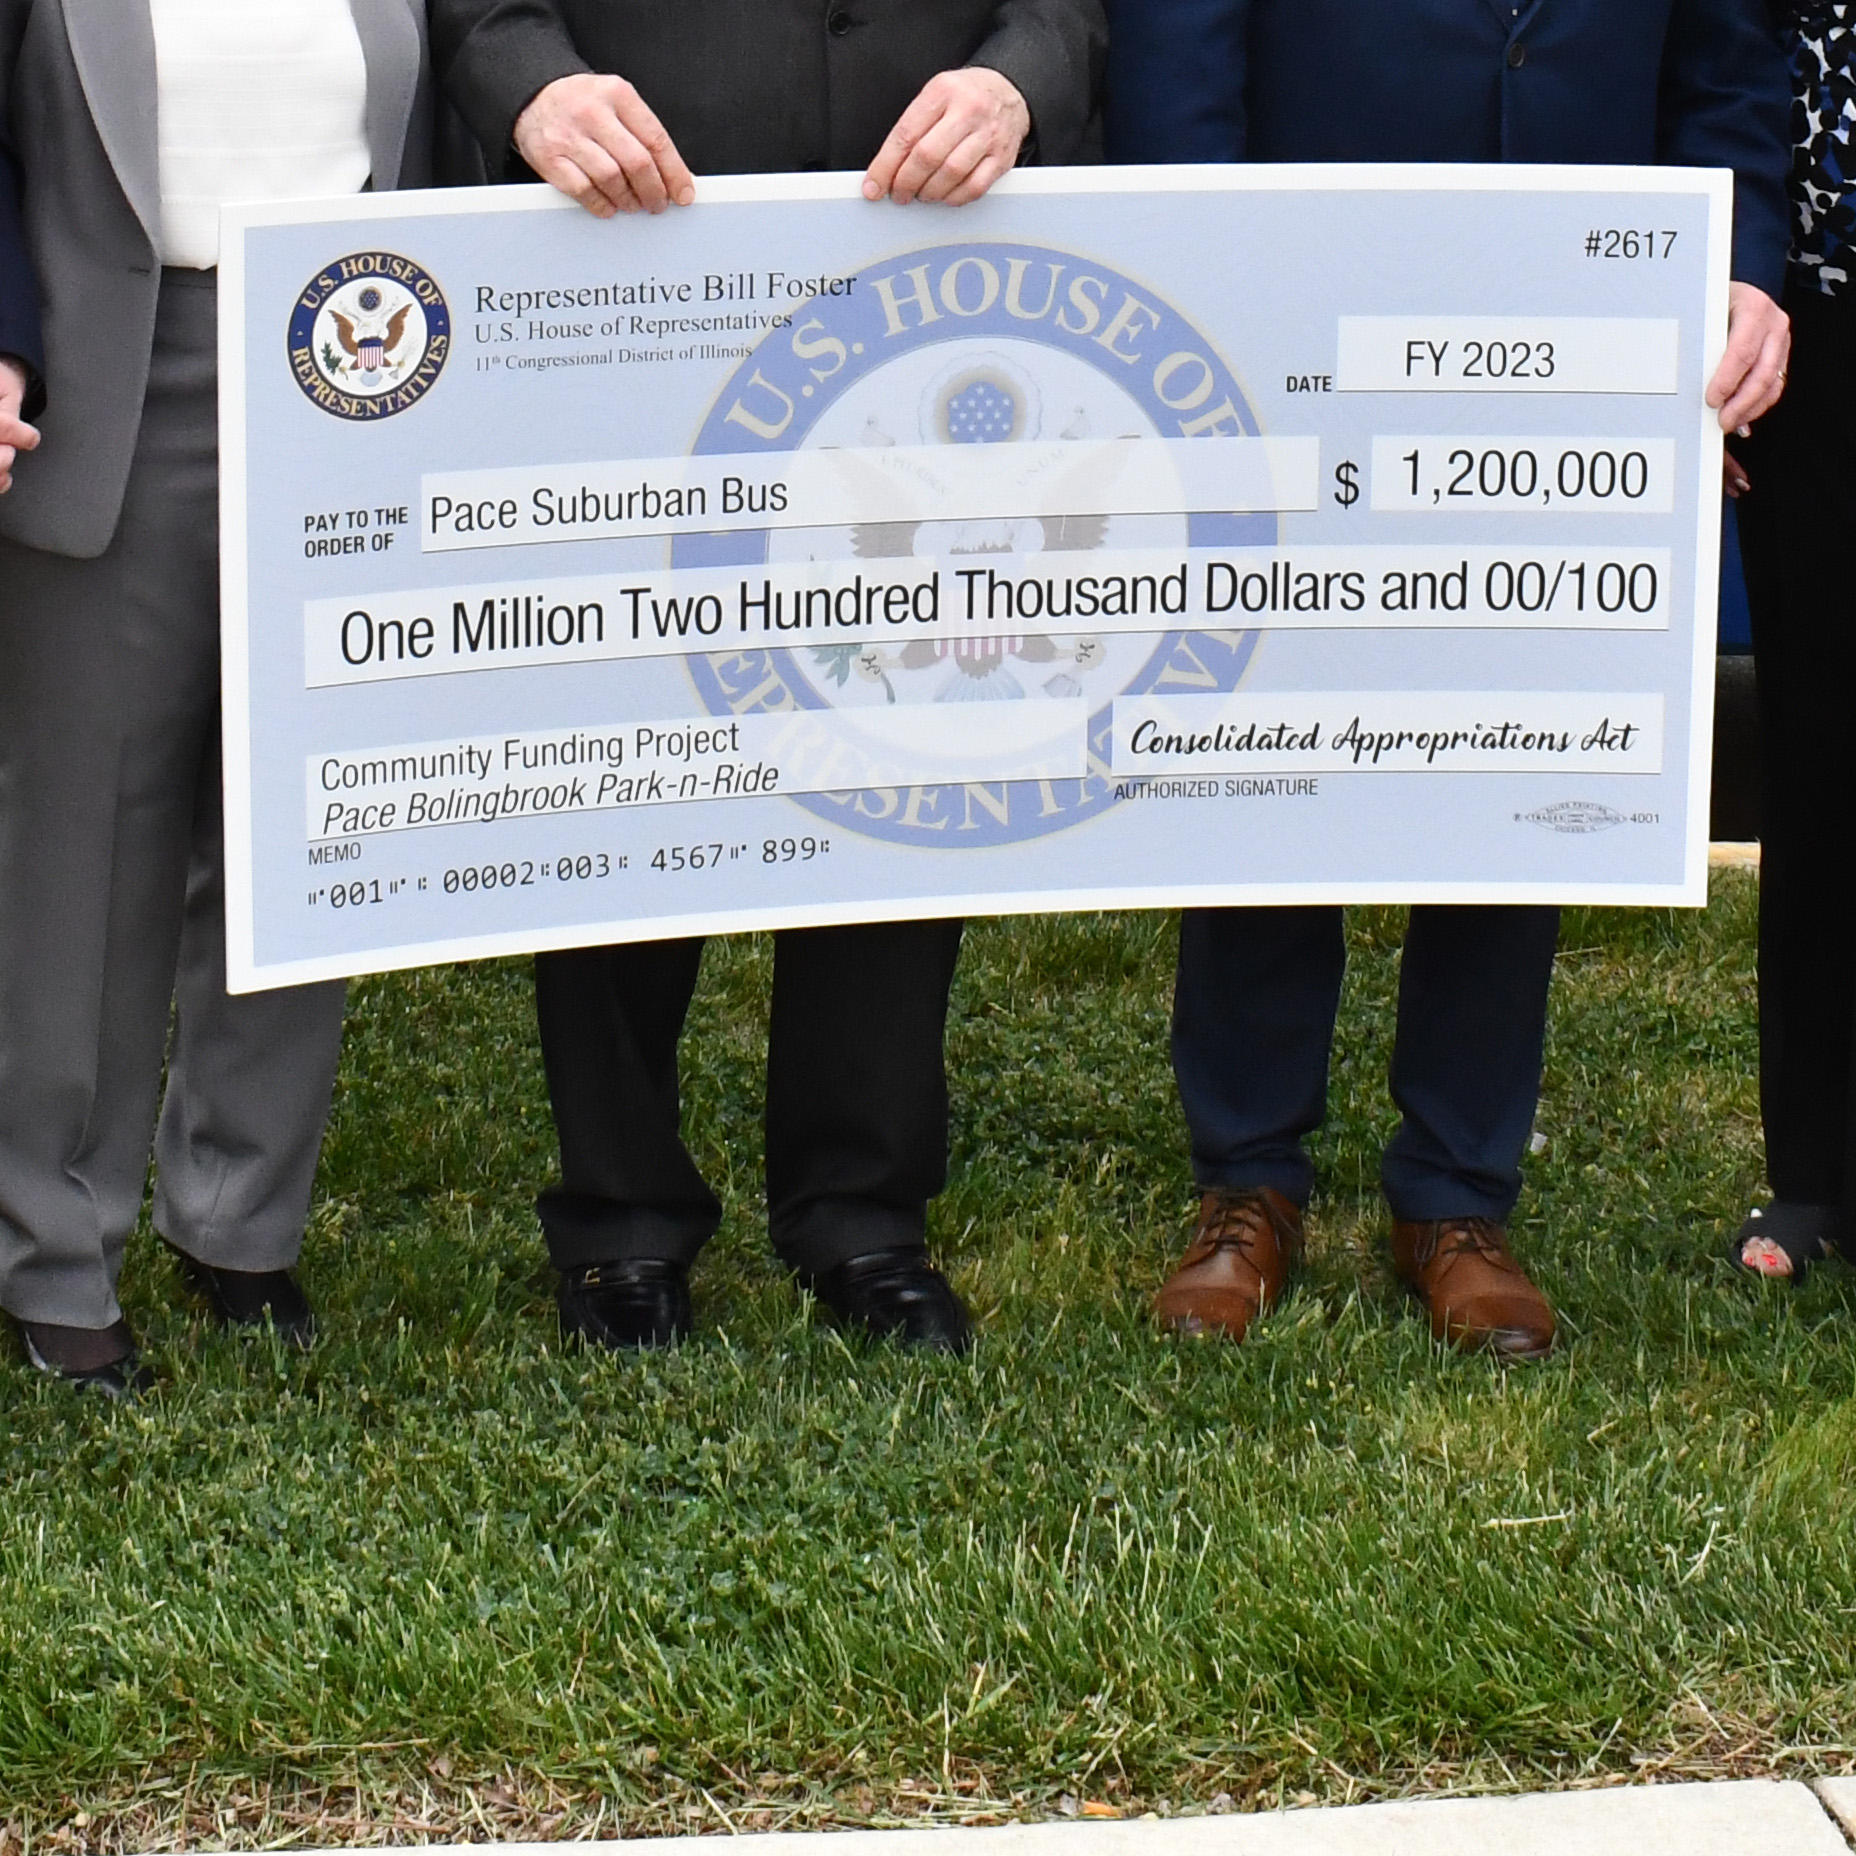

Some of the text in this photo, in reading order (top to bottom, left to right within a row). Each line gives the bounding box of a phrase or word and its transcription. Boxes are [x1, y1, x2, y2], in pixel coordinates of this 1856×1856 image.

[1584, 230, 1678, 259] #2617
[301, 255, 443, 309] U.S. HOUSE OF
[475, 271, 857, 318] Representative Bill Foster
[475, 310, 793, 343] U.S. House of Representatives
[505, 348, 613, 371] Congressional
[618, 346, 674, 364] District
[679, 344, 697, 360] of
[699, 343, 753, 360] Illinois
[725, 256, 1248, 442] U.S. HOUSE OF
[1405, 340, 1556, 377] FY 2023
[292, 335, 447, 417] REPRESENTATIVES
[1285, 375, 1333, 393] DATE
[1334, 449, 1648, 509] $ 1,200,000
[304, 506, 409, 533] PAY TO THE
[430, 477, 789, 534] Pace Suburban Bus
[304, 532, 395, 558] ORDER OF
[340, 560, 1658, 666] One Million Two Hundred Thousand Dollars and 00/100
[321, 722, 740, 792] Community Funding Project
[1131, 715, 1641, 764] Consolidated Appropriations Act
[324, 761, 780, 835] Pace Bolingbrook Park-n-Ride
[1114, 778, 1318, 800] AUTHORIZED SIGNATURE
[1630, 813, 1660, 824] 4001
[307, 842, 362, 866] MEMO
